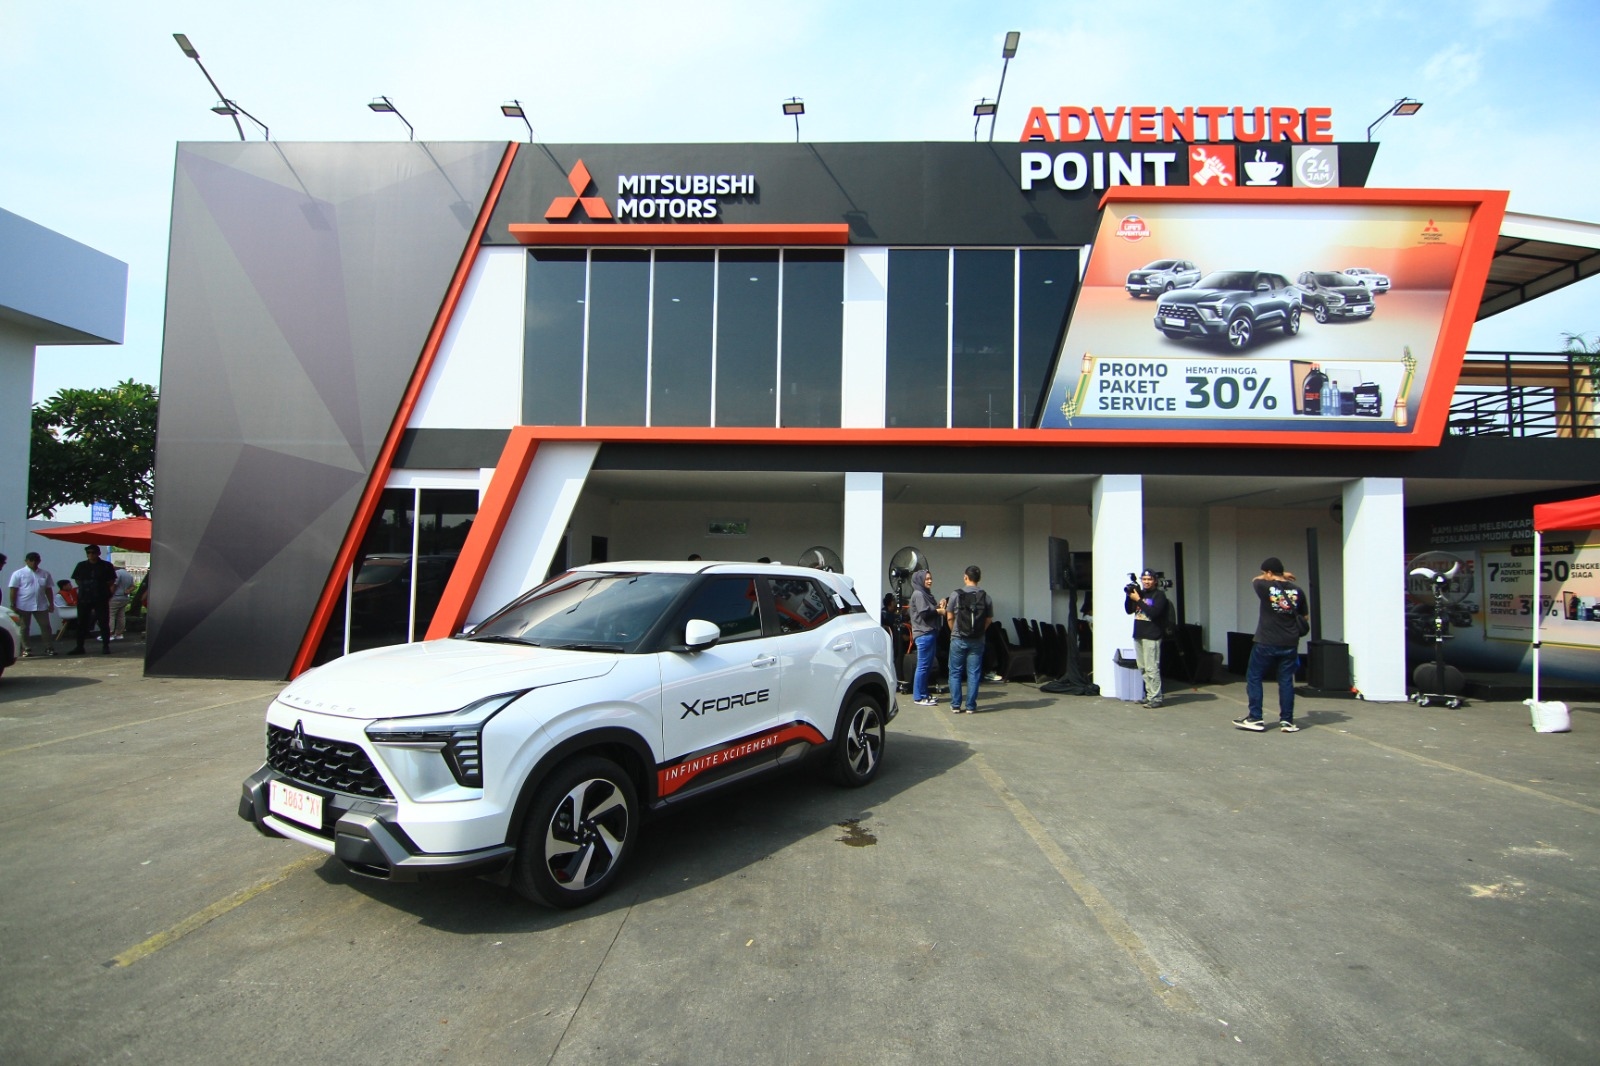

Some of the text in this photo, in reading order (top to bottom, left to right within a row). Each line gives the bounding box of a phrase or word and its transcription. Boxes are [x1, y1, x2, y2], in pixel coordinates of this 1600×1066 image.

[1019, 106, 1333, 142] ADVENTURE
[1020, 152, 1176, 191] POINT
[1307, 159, 1329, 172] 24
[618, 174, 755, 194] MITSUBISHI
[1307, 173, 1329, 181] JAM
[617, 198, 717, 218] MOTORS
[1099, 363, 1168, 377] PROMO
[1185, 366, 1258, 375] HEMAT HINGGA
[1099, 380, 1160, 394] PAKET
[1185, 376, 1277, 410] 30%
[1098, 397, 1176, 411] SERVICE
[1482, 531, 1511, 541] MUDIK
[1488, 562, 1499, 582] 7
[1540, 560, 1570, 582] 50
[1570, 562, 1600, 570] BENGKE
[680, 689, 769, 719] XFORCE
[665, 735, 779, 781] INFINITE XCITEMENT
[272, 784, 278, 801] T
